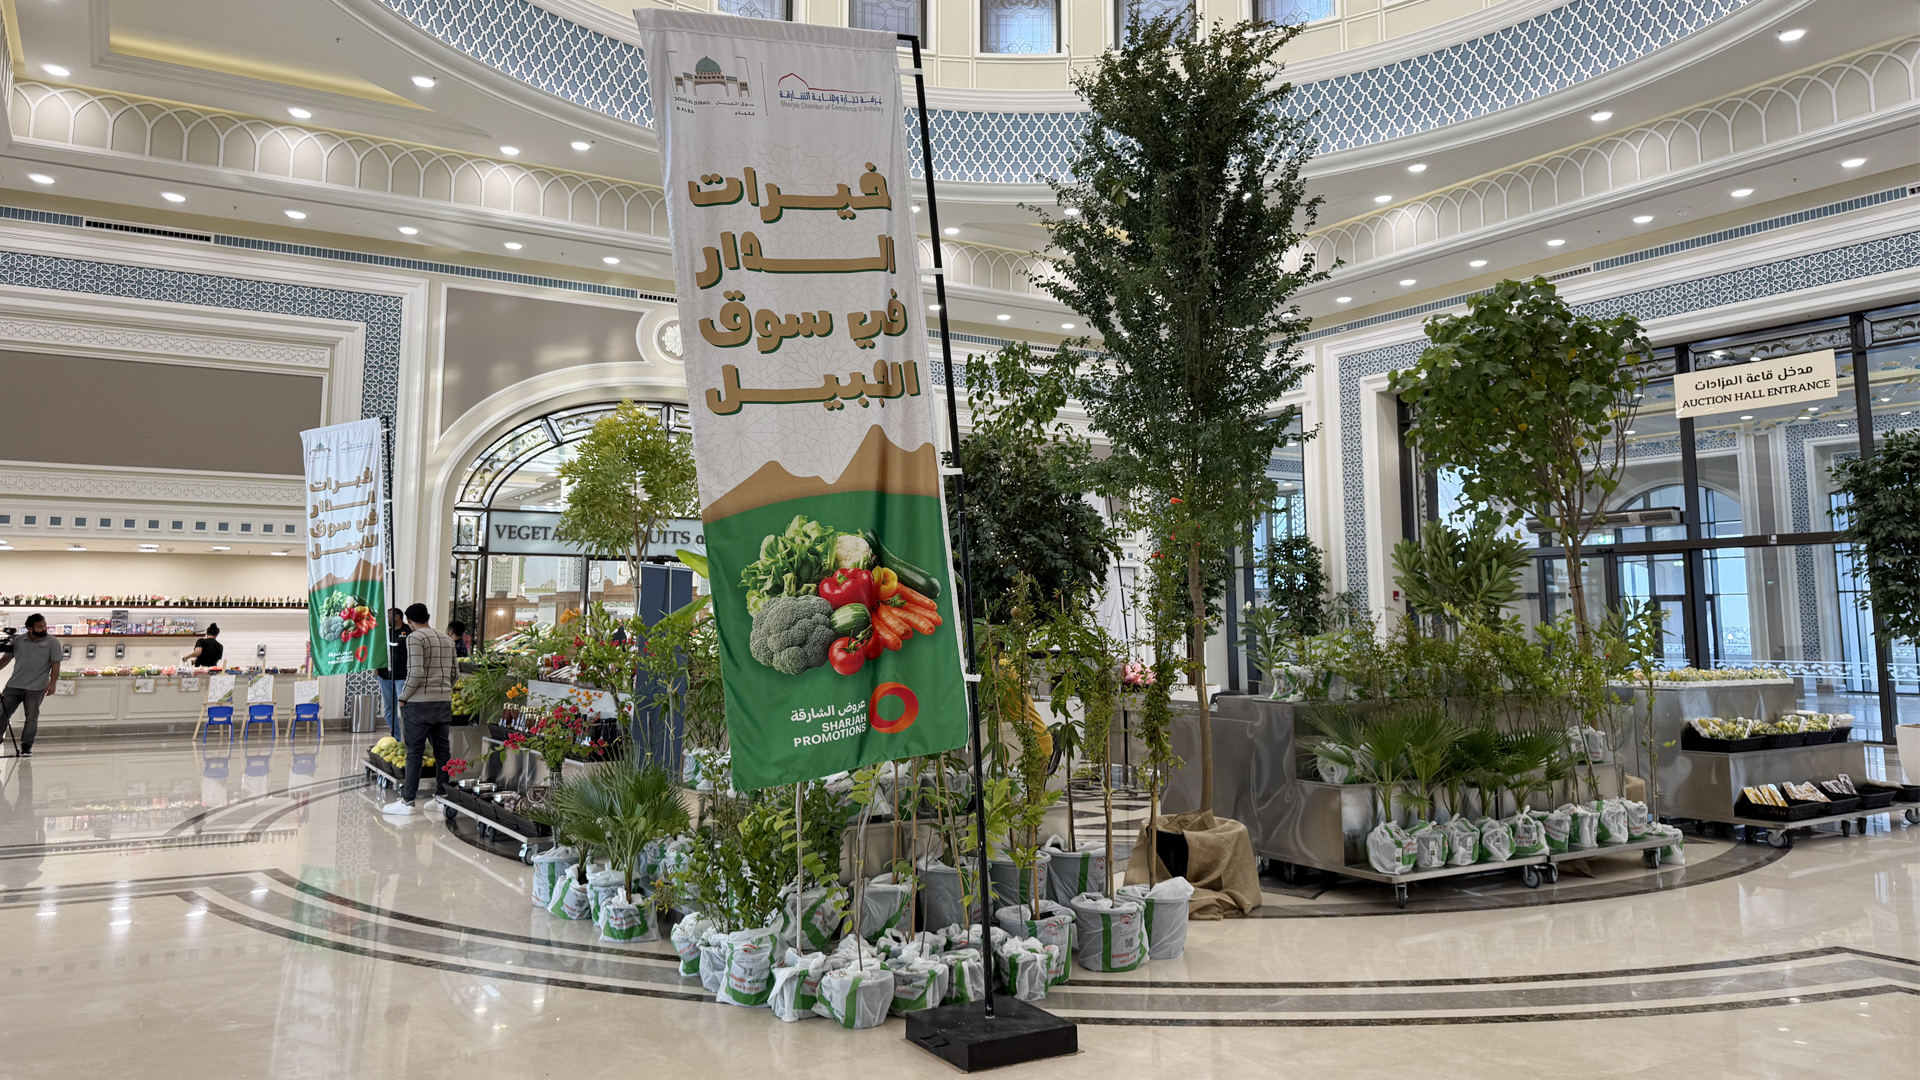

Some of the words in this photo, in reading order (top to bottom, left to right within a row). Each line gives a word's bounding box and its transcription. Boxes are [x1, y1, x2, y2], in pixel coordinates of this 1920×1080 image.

[780, 100, 800, 110] Sharjah
[800, 102, 824, 111] Chamber
[831, 104, 857, 112] Commerce
[863, 105, 884, 115] Industry
[687, 161, 892, 223] خيرات
[695, 230, 896, 290] الدار
[698, 289, 834, 354] سوق
[846, 288, 908, 349] في
[1694, 375, 1742, 391] المزادات
[1746, 370, 1773, 383] قاعة
[1777, 365, 1813, 381] مدخل
[705, 359, 921, 416] الجبيل
[1682, 393, 1732, 409] AUCTION
[1734, 389, 1765, 402] HALL
[1767, 379, 1831, 397] ENTRANCE
[309, 519, 351, 538] سوق
[356, 508, 379, 533] في
[641, 530, 691, 545] UITS
[790, 704, 835, 723] الشارقة
[837, 700, 866, 717] عروض
[821, 712, 867, 733] SHARJAH
[793, 722, 867, 748] PROMOTIONS
